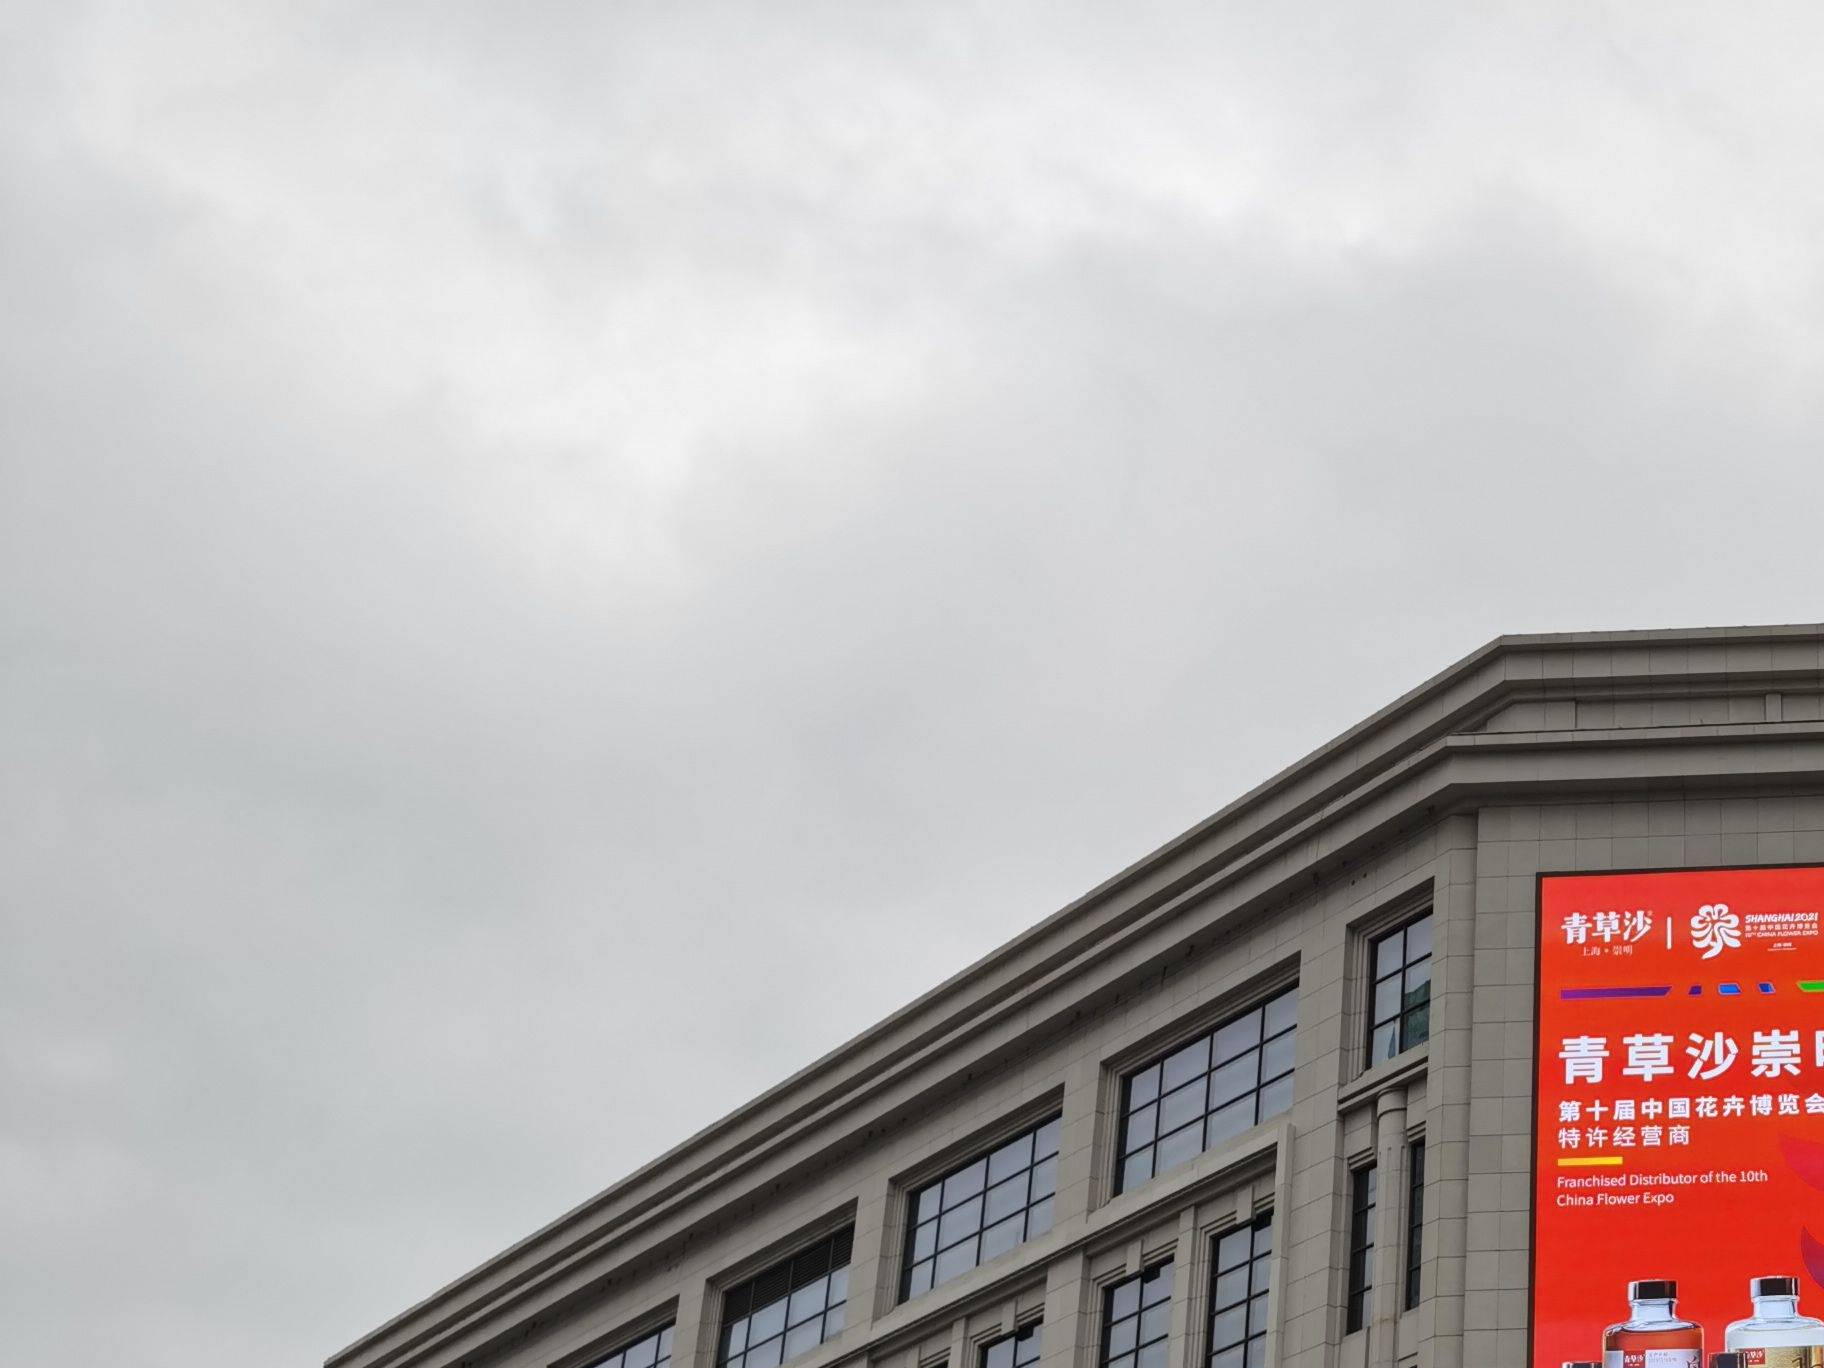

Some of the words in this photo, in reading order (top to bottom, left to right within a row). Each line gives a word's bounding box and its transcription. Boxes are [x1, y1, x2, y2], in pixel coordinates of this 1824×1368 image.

[1744, 913, 1795, 924] SHANGHAI
[1795, 911, 1820, 923] 2021
[1560, 910, 1653, 945] 青草沙
[1557, 1124, 1691, 1149] 特许经营商
[1557, 1175, 1627, 1188] Franchised
[1629, 1171, 1698, 1186] Distributor
[1699, 1171, 1714, 1184] of
[1715, 1170, 1737, 1183] the
[1739, 1169, 1769, 1183] 10th
[1556, 1194, 1594, 1207] China
[1597, 1192, 1641, 1205] Flower
[1643, 1191, 1675, 1207] Expo
